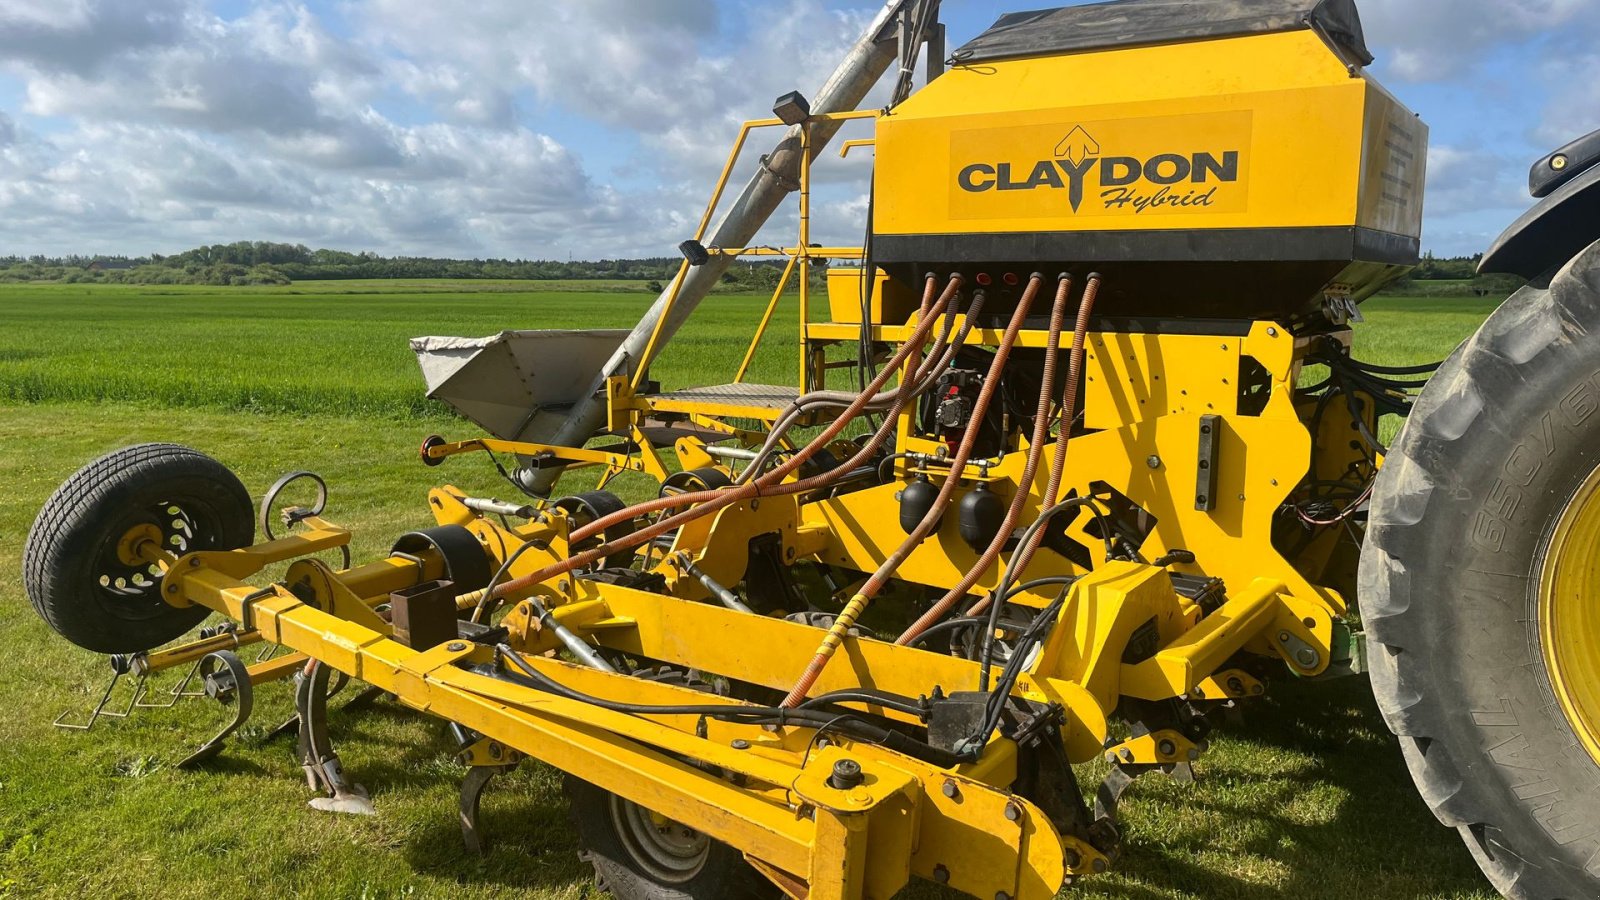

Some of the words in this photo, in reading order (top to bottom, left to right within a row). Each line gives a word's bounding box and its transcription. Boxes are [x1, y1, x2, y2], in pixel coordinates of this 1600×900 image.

[957, 151, 1239, 214] CLAYDON
[1100, 186, 1217, 214] Hybrid
[1472, 367, 1600, 554] 650/6
